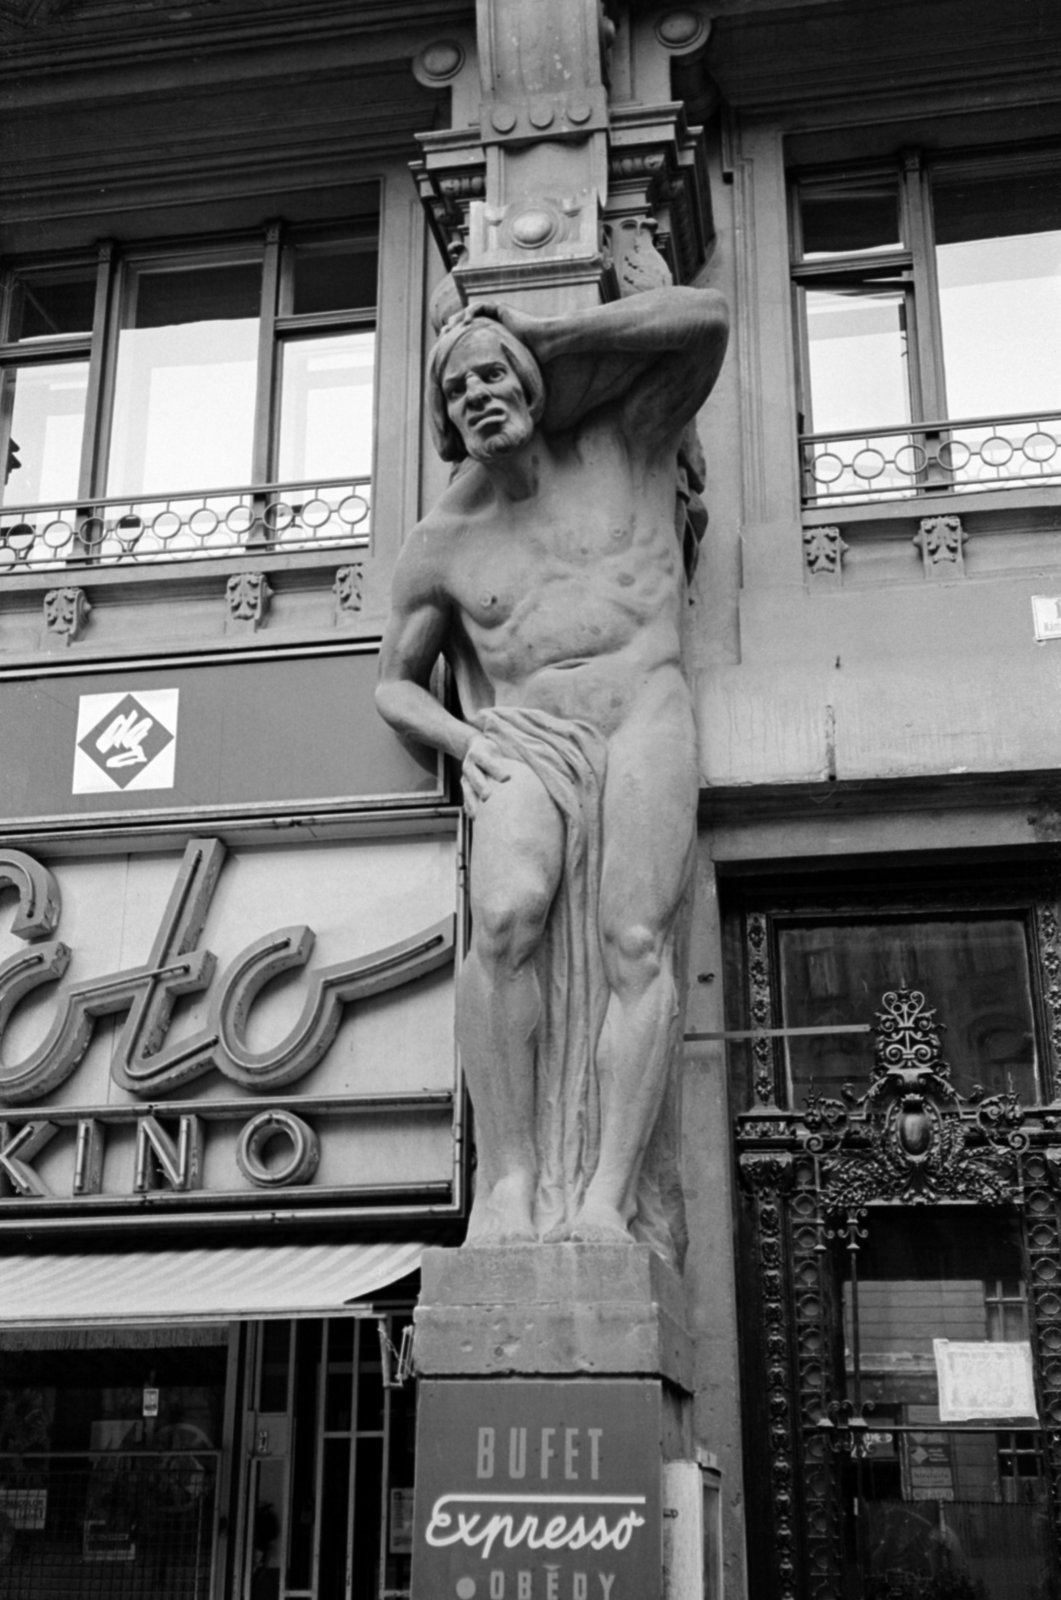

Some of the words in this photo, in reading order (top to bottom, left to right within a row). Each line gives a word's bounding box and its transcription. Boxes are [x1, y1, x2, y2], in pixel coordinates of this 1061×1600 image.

[0, 1109, 320, 1197] KINO
[476, 1426, 603, 1480] BUFET
[425, 1493, 646, 1559] Expresso
